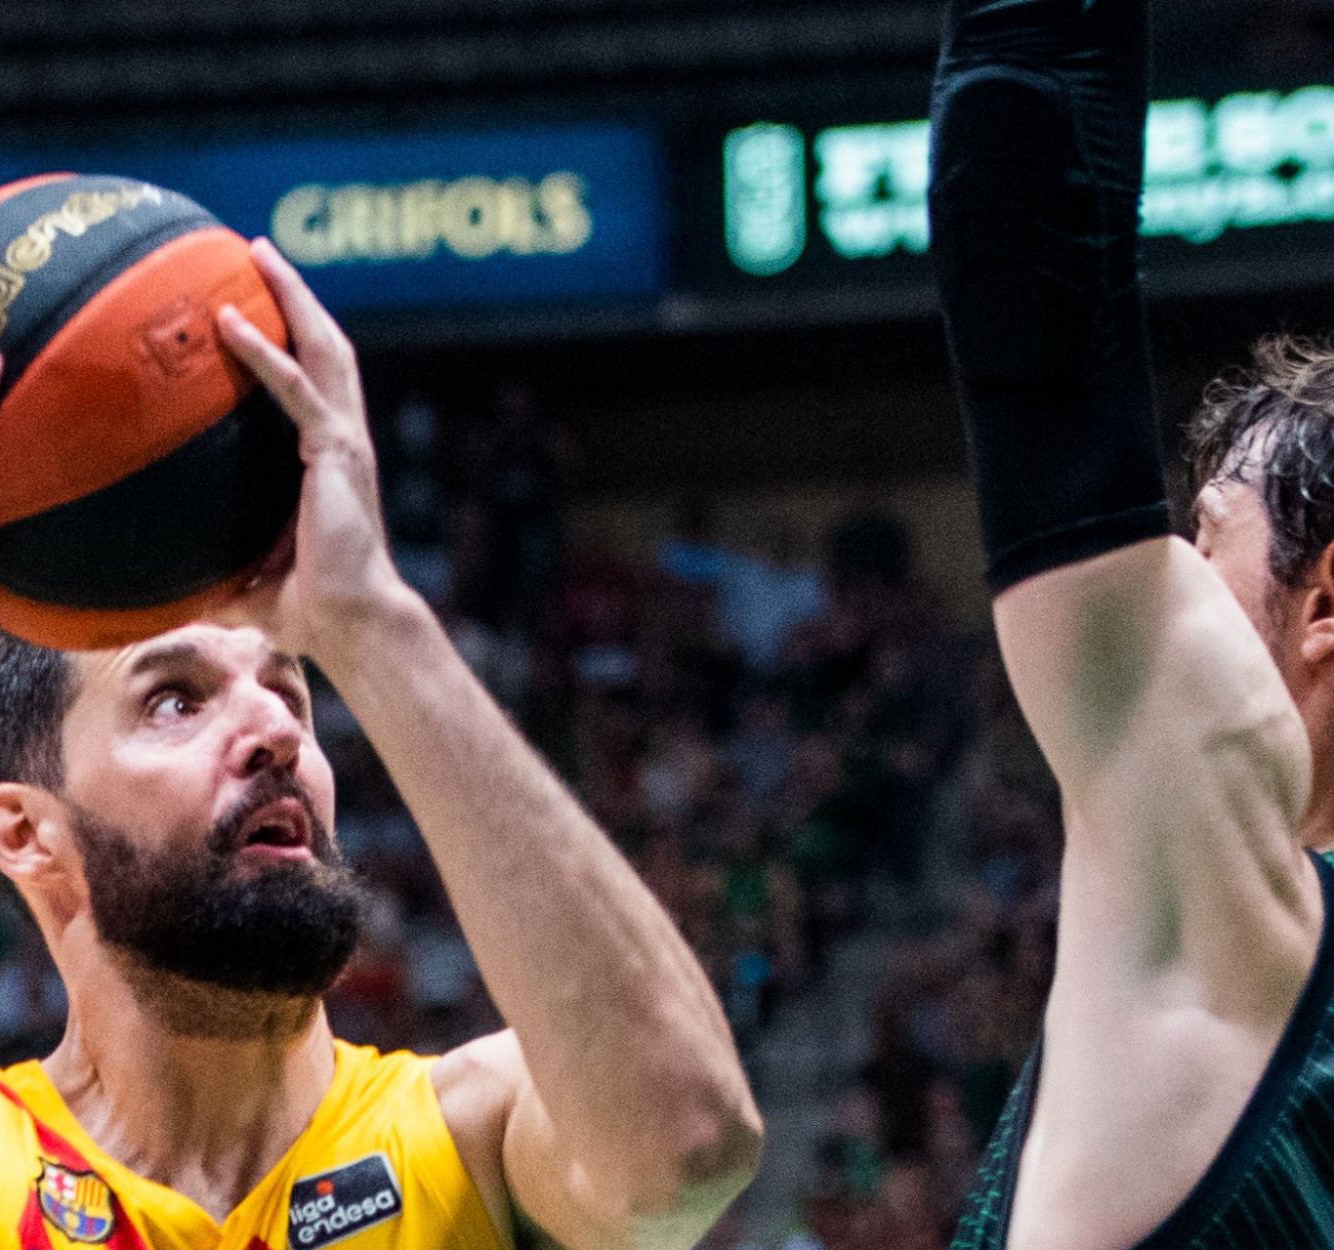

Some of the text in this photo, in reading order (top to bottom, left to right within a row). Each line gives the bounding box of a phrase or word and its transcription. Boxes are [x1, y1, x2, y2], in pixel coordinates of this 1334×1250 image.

[269, 171, 591, 266] GRIFOLS
[290, 1194, 335, 1225] liga
[298, 1189, 394, 1243] endesa
